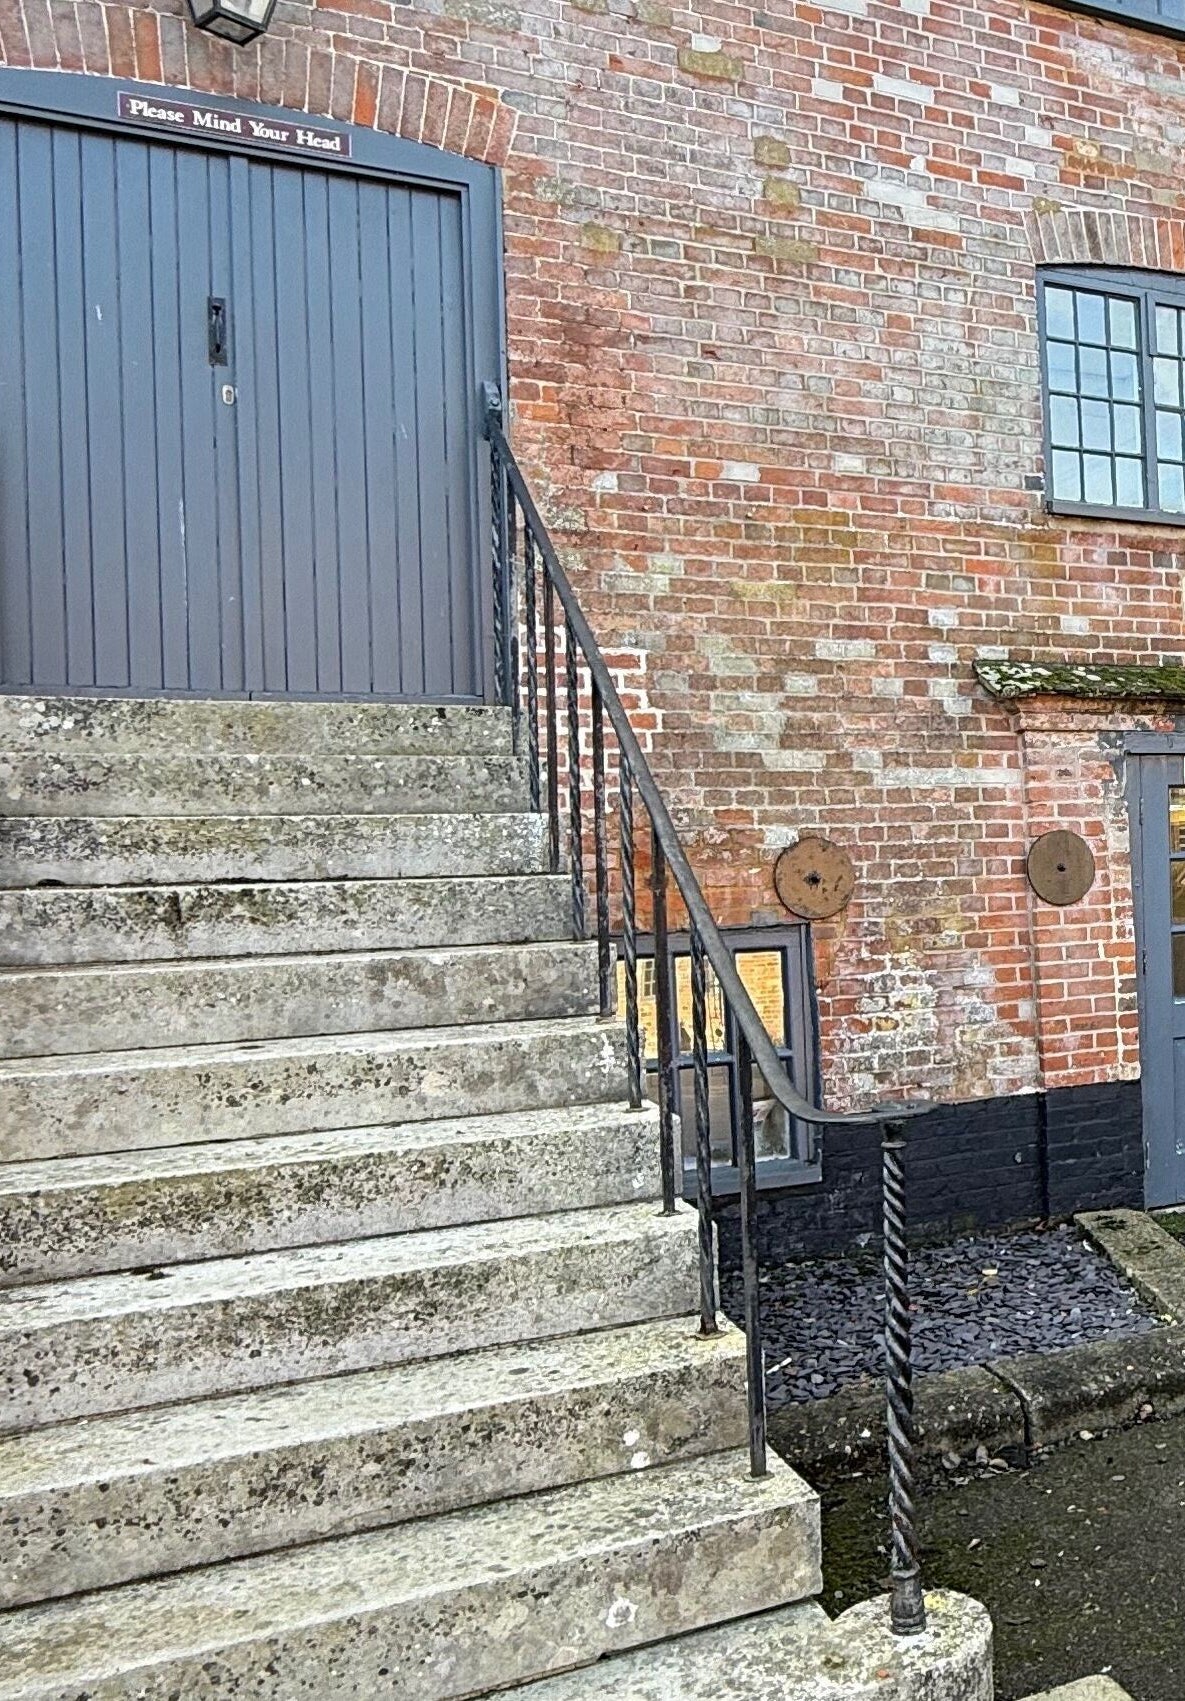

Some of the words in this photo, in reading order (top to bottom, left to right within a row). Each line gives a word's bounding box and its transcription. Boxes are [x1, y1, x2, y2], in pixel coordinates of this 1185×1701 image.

[129, 98, 185, 123] Please
[191, 109, 242, 134] Mind
[248, 119, 290, 142] Your
[295, 129, 341, 151] Head
